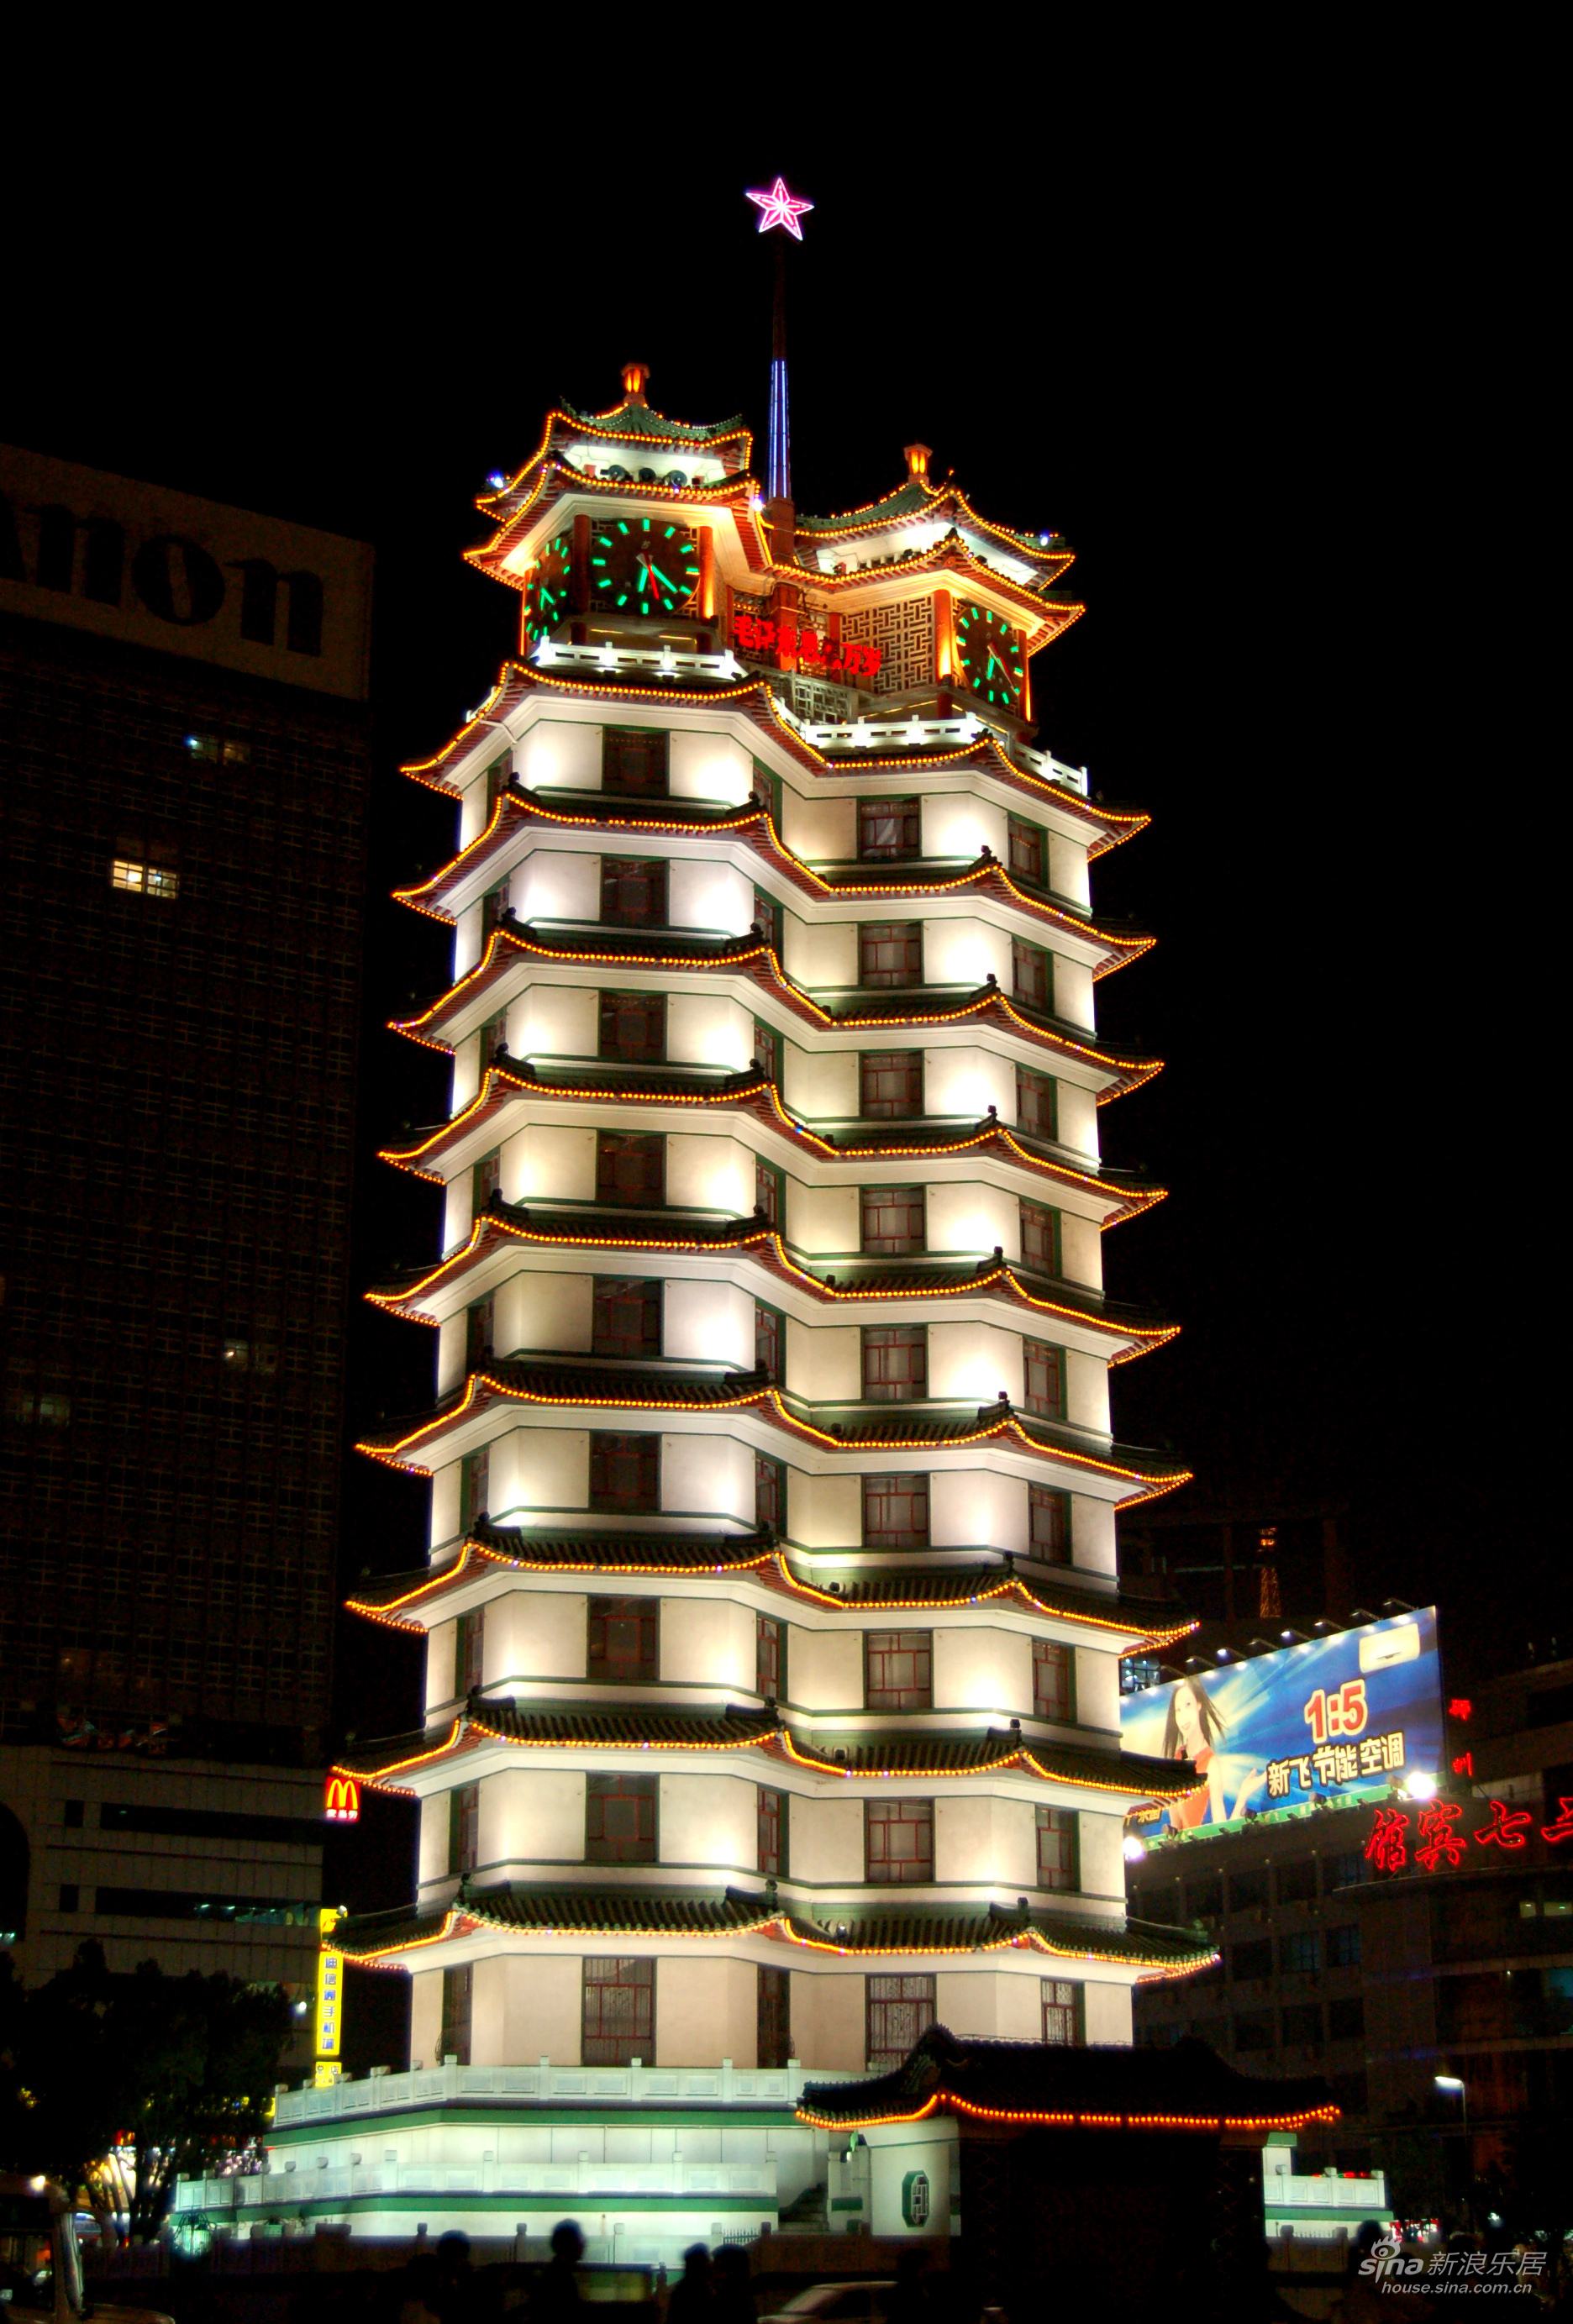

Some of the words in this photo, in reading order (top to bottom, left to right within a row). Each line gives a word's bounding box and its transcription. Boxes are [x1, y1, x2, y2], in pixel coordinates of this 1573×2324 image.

[1305, 1680, 1368, 1744] 1:5
[1267, 1731, 1404, 1798] 新飞节能空调
